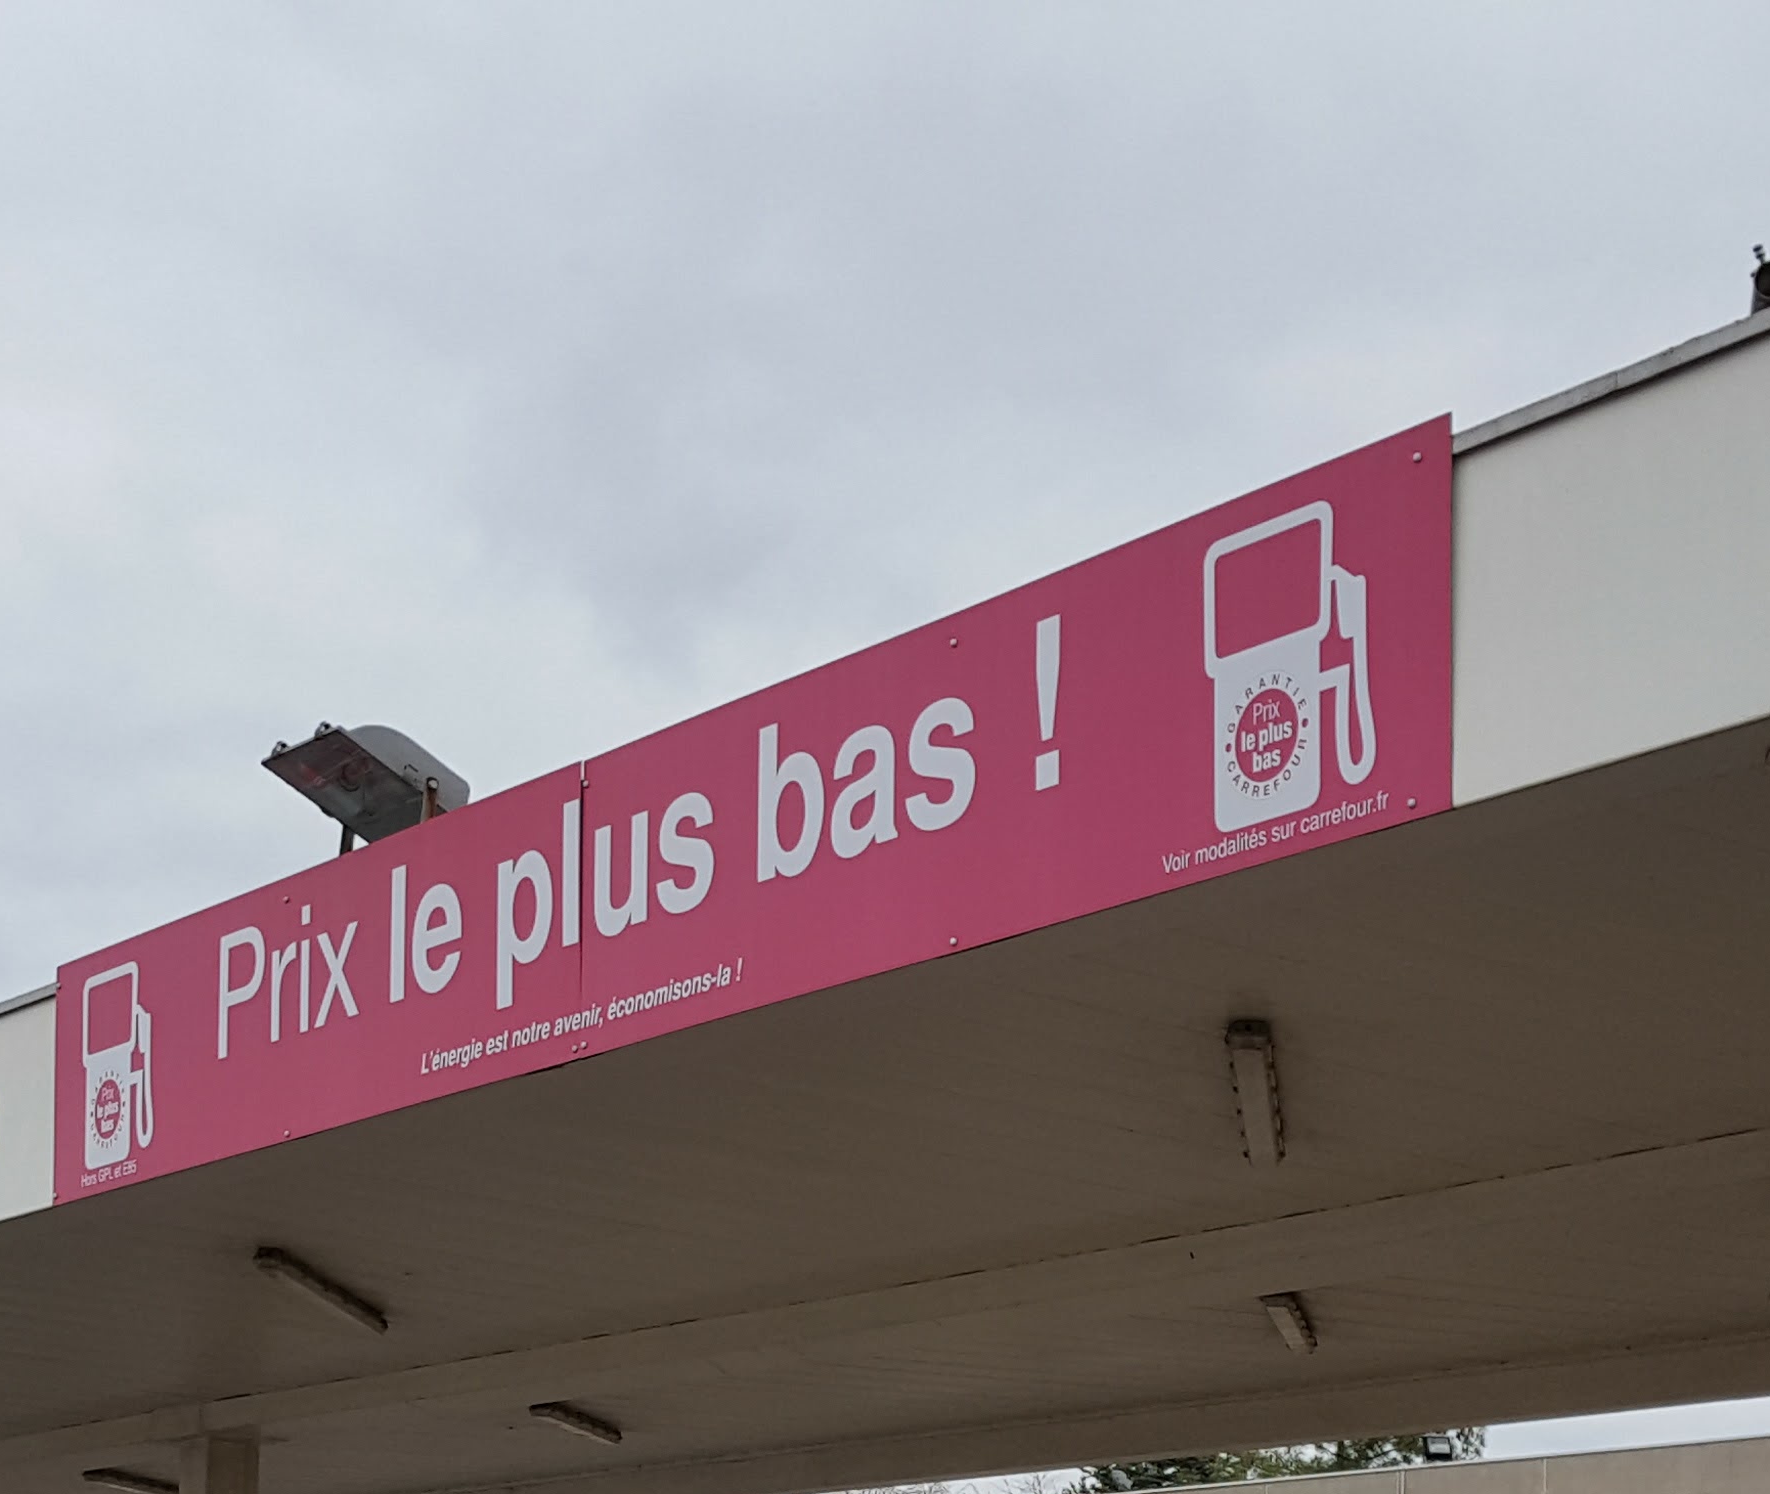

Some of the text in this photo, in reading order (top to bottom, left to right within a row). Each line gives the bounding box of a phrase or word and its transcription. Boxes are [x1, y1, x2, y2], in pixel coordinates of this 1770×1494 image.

[1227, 673, 1307, 733] GARANTIE
[1253, 699, 1280, 725] Prix
[1241, 721, 1293, 752] le plus
[1252, 749, 1281, 773] bas
[1227, 739, 1307, 797] CARREFOUR
[218, 614, 1061, 1059] Prix le plus bas !
[1162, 790, 1389, 874] Voir modalités sur carrefour.fr
[421, 1040, 482, 1075] L'énergie
[486, 1031, 508, 1056] est
[512, 1021, 550, 1048] notre
[554, 1004, 604, 1036] avenir,
[608, 964, 731, 1020] économisons-la
[81, 1174, 97, 1187] Hors
[98, 1168, 113, 1183] GPL
